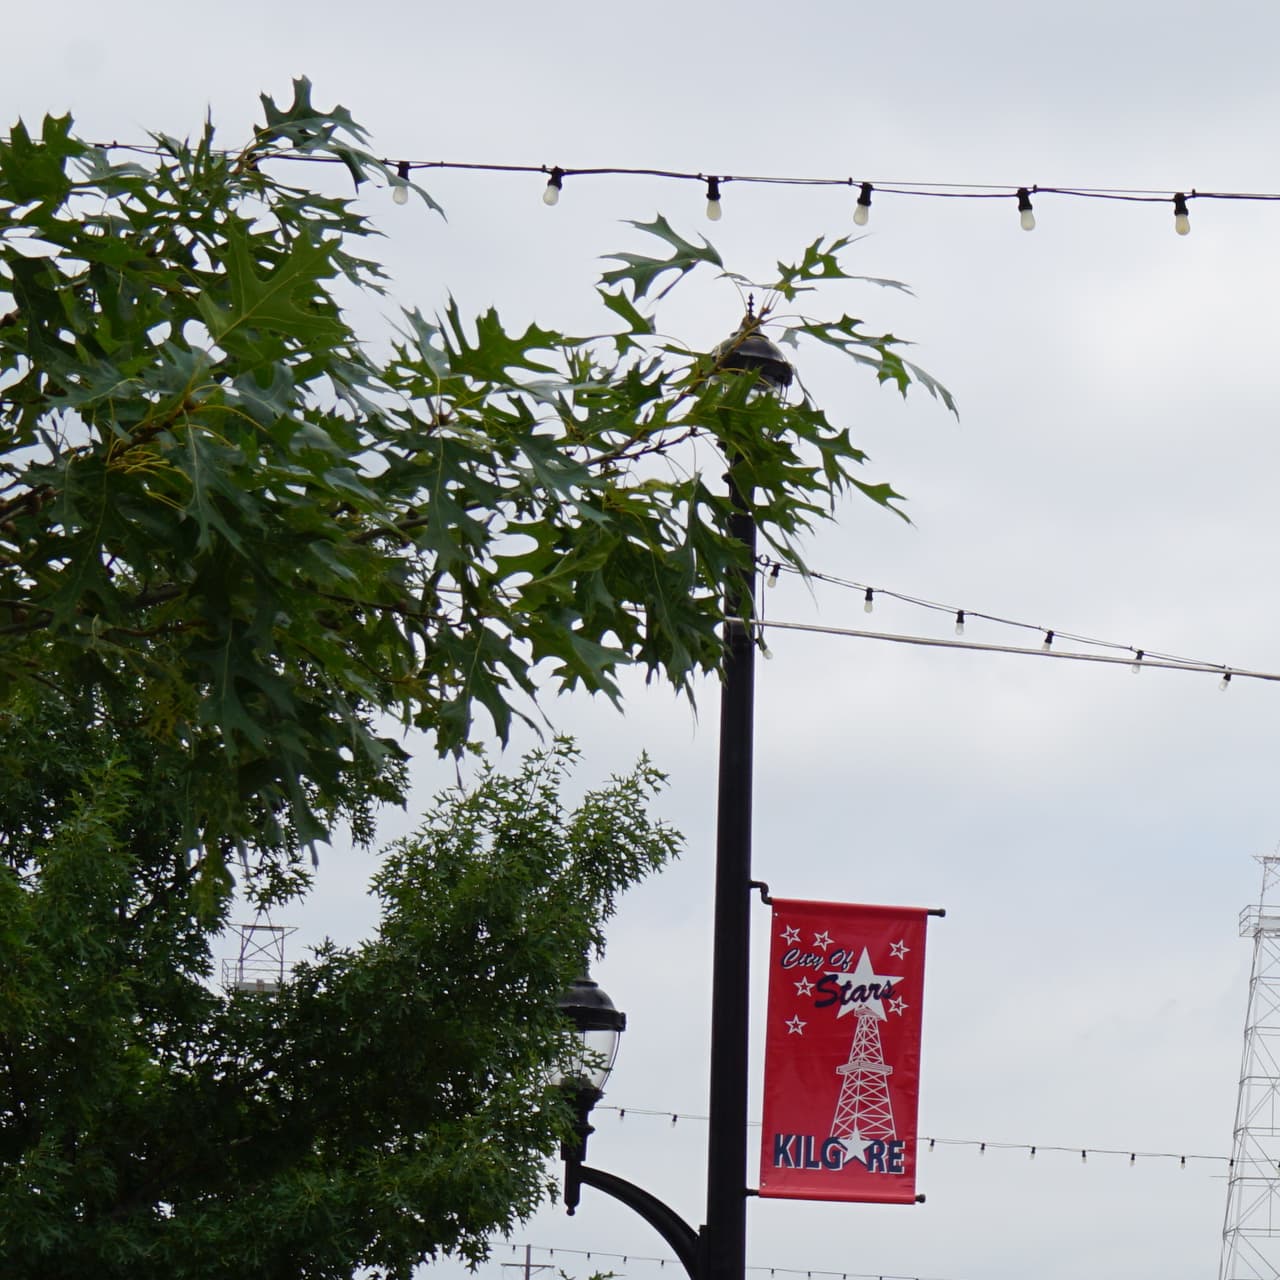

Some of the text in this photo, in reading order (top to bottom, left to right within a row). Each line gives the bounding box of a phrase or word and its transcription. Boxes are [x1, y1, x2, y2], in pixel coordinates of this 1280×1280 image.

[781, 948, 854, 972] City Of
[814, 973, 897, 1008] Stars
